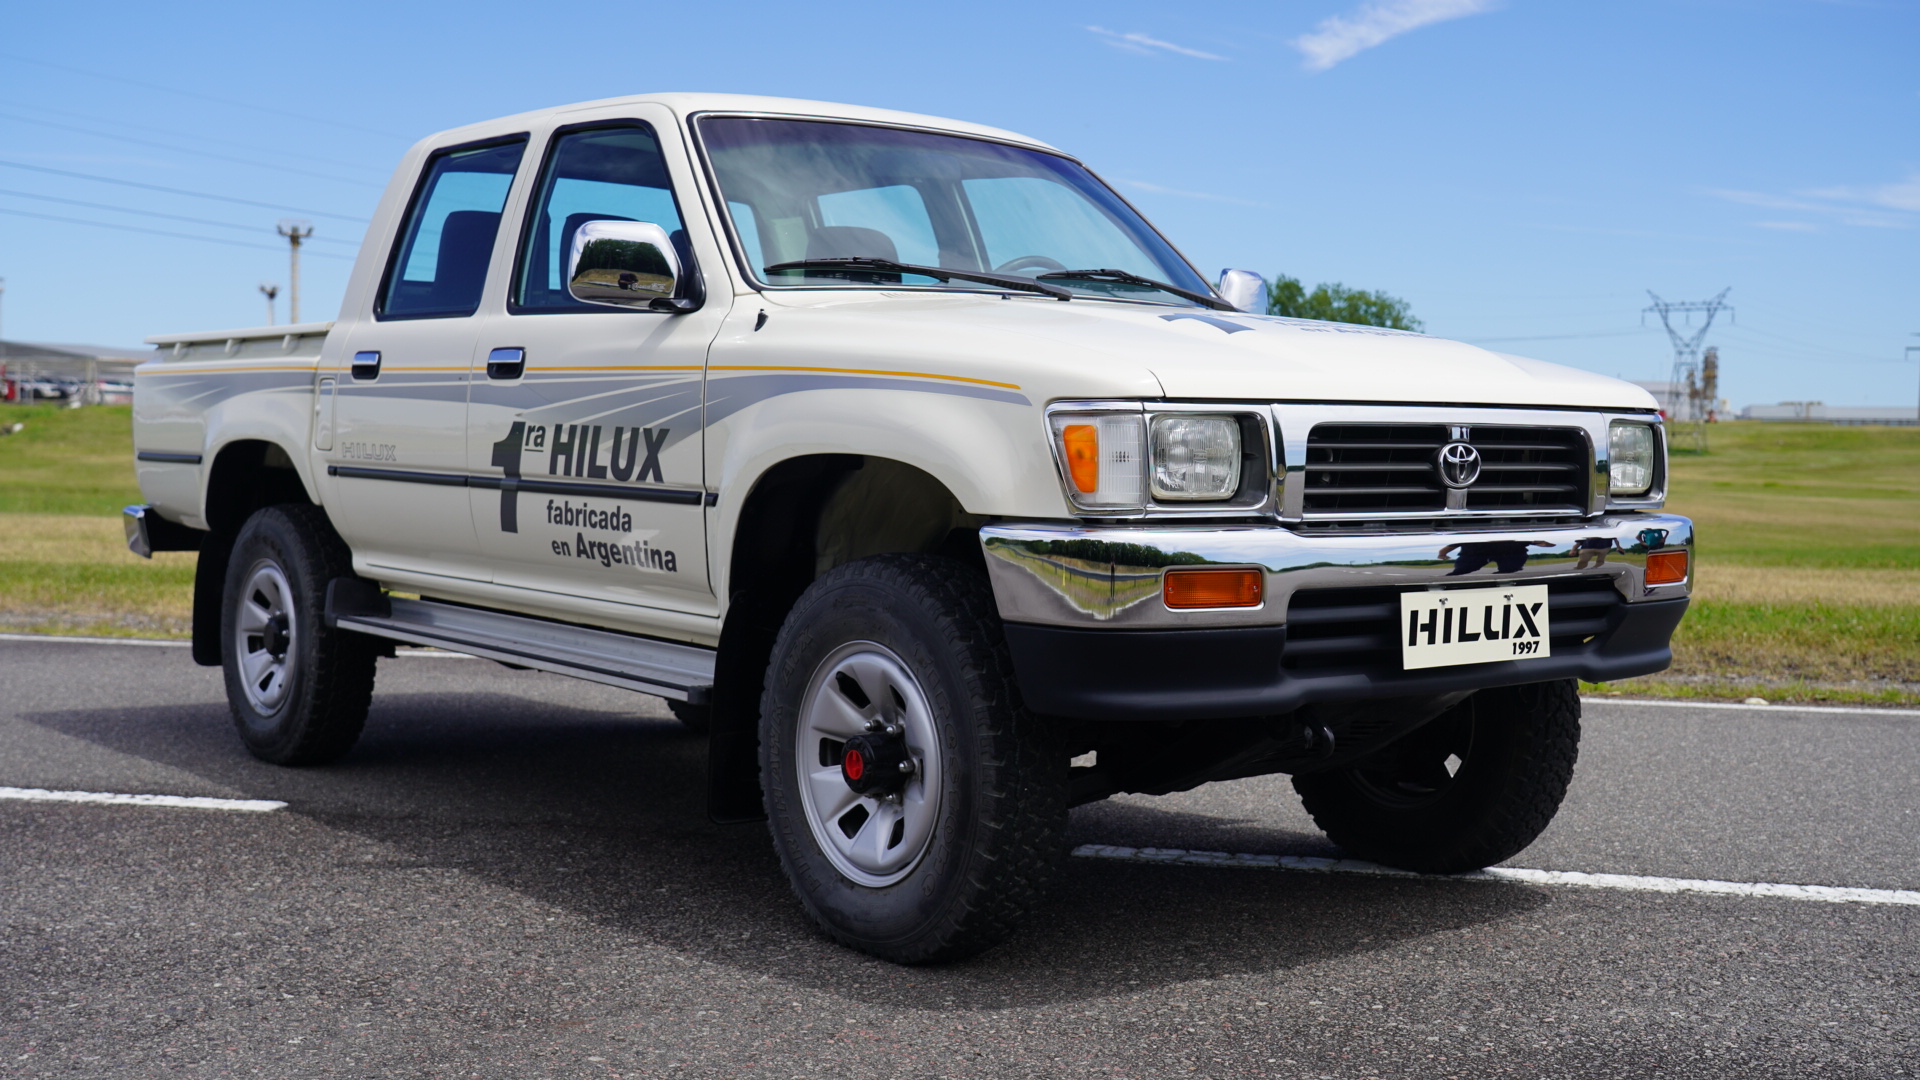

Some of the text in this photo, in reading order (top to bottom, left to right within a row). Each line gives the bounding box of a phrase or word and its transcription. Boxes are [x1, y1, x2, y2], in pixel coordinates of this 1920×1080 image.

[341, 441, 397, 462] HILUX
[491, 421, 671, 534] 1ra HILUX
[547, 499, 633, 533] fabricada
[551, 532, 678, 573] en Argentina
[1408, 602, 1544, 647] HILUX
[780, 624, 815, 687] ATX
[1512, 640, 1540, 655] 1997
